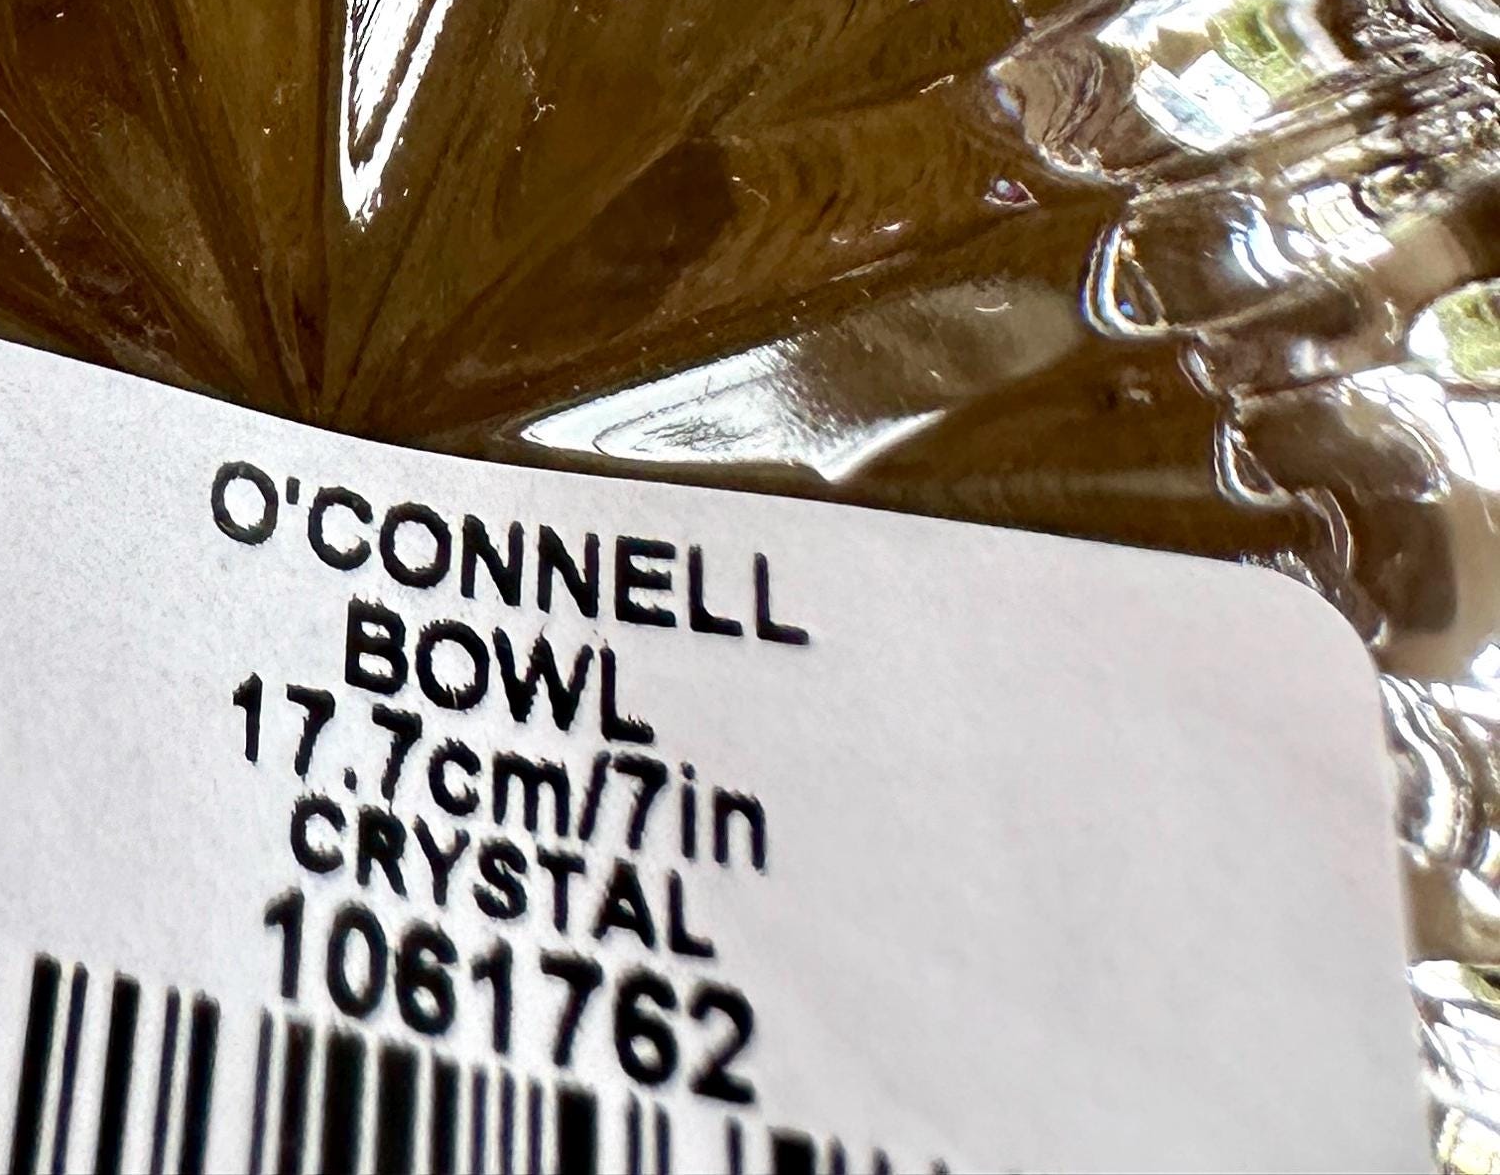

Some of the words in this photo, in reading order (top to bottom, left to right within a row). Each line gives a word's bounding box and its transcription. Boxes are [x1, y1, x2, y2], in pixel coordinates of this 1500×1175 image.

[210, 461, 811, 646] O'CONNELL
[344, 594, 656, 747] BOWL
[232, 672, 768, 874] 17.7cm/7in
[290, 792, 715, 959] CRYSTAL
[263, 889, 756, 1107] 1061762
